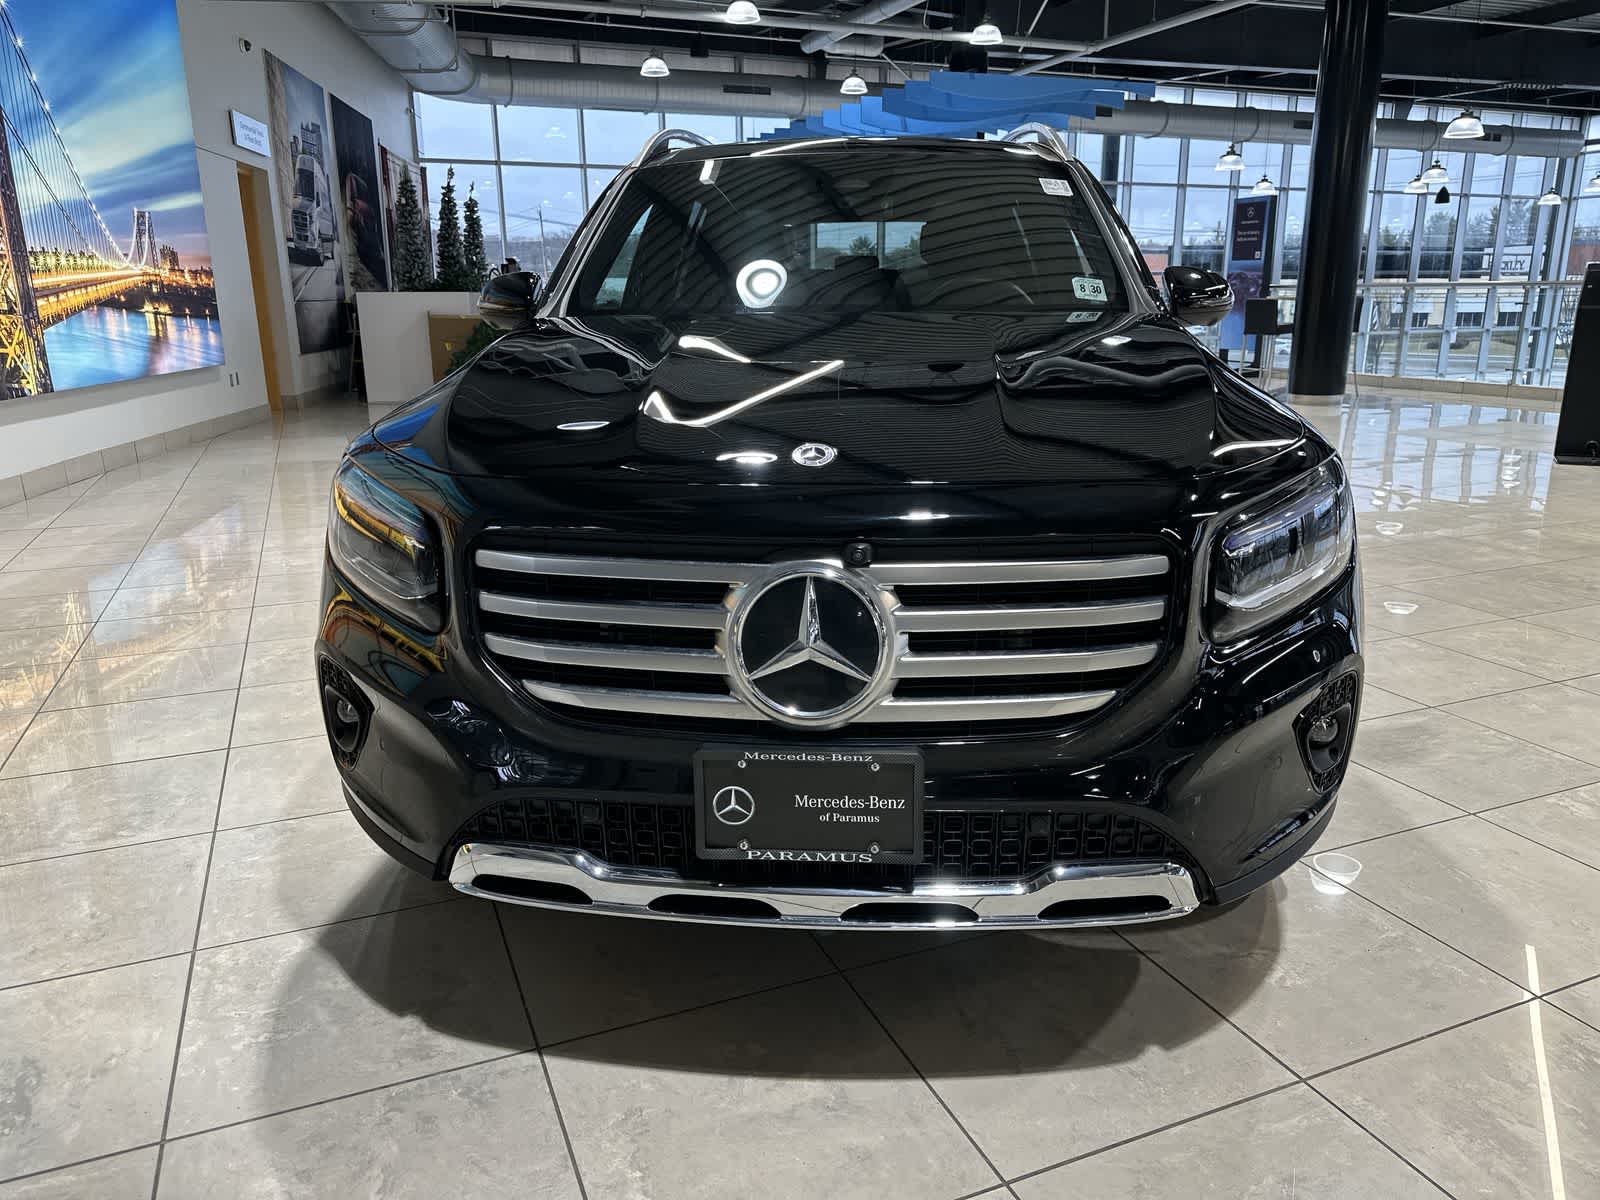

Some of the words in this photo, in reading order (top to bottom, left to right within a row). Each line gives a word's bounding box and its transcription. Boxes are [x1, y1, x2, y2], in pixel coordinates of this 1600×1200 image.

[1080, 284, 1086, 292] 8
[1090, 285, 1102, 294] 30
[744, 752, 873, 762] Mercedes-Benz
[794, 794, 905, 809] Mercedes-Benz
[819, 812, 831, 822] of
[833, 813, 880, 823] Paramus
[747, 850, 873, 863] PARAMUS
